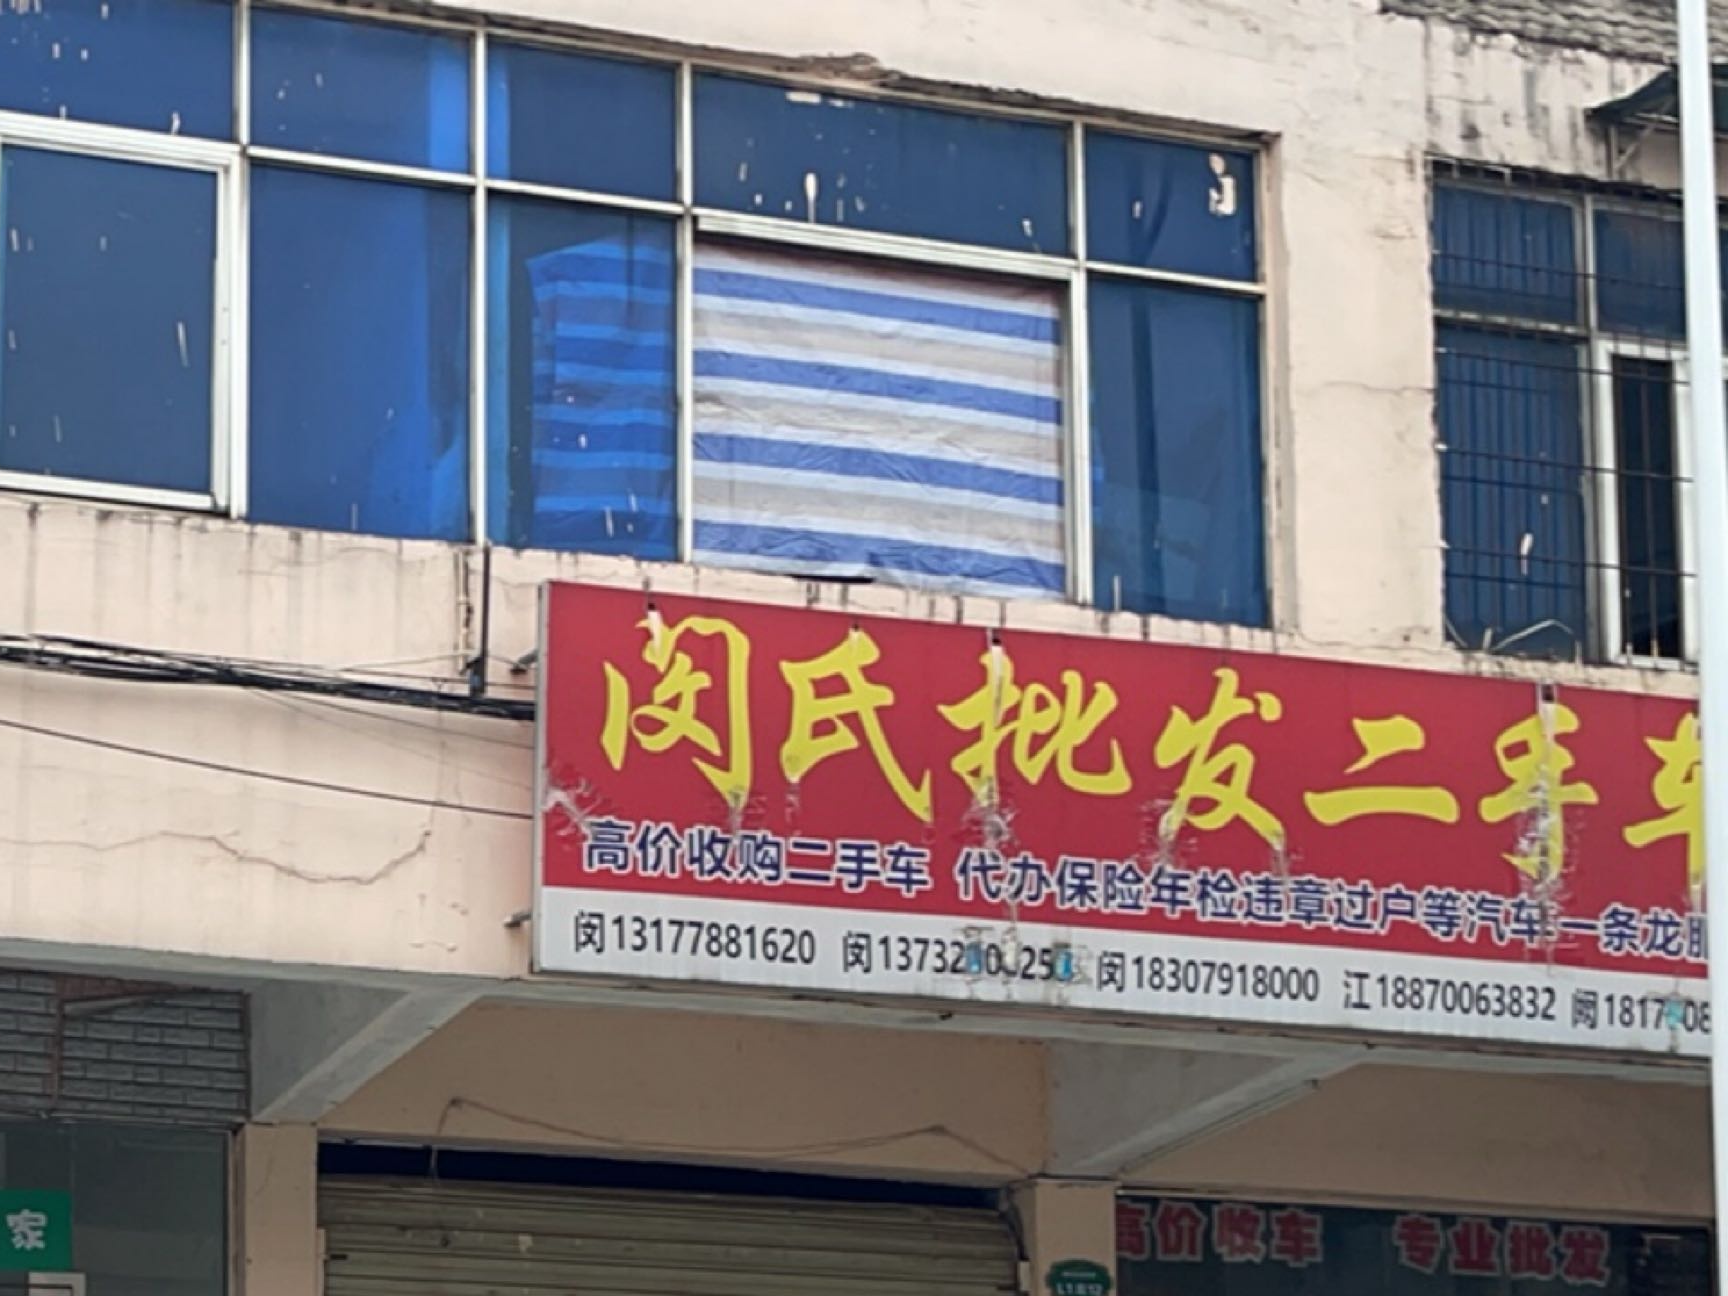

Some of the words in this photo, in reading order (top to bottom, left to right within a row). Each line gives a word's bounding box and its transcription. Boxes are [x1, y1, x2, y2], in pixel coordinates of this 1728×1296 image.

[584, 819, 932, 895] 高价收购二手车
[574, 909, 817, 965] 闵13177881620
[842, 930, 1072, 981] 闵13732025
[1096, 950, 1320, 1002] 闵18307918000
[1343, 969, 1557, 1021] 江18870063832
[1116, 1203, 1320, 1266] 高价收车
[1393, 1212, 1609, 1286] 专业批发
